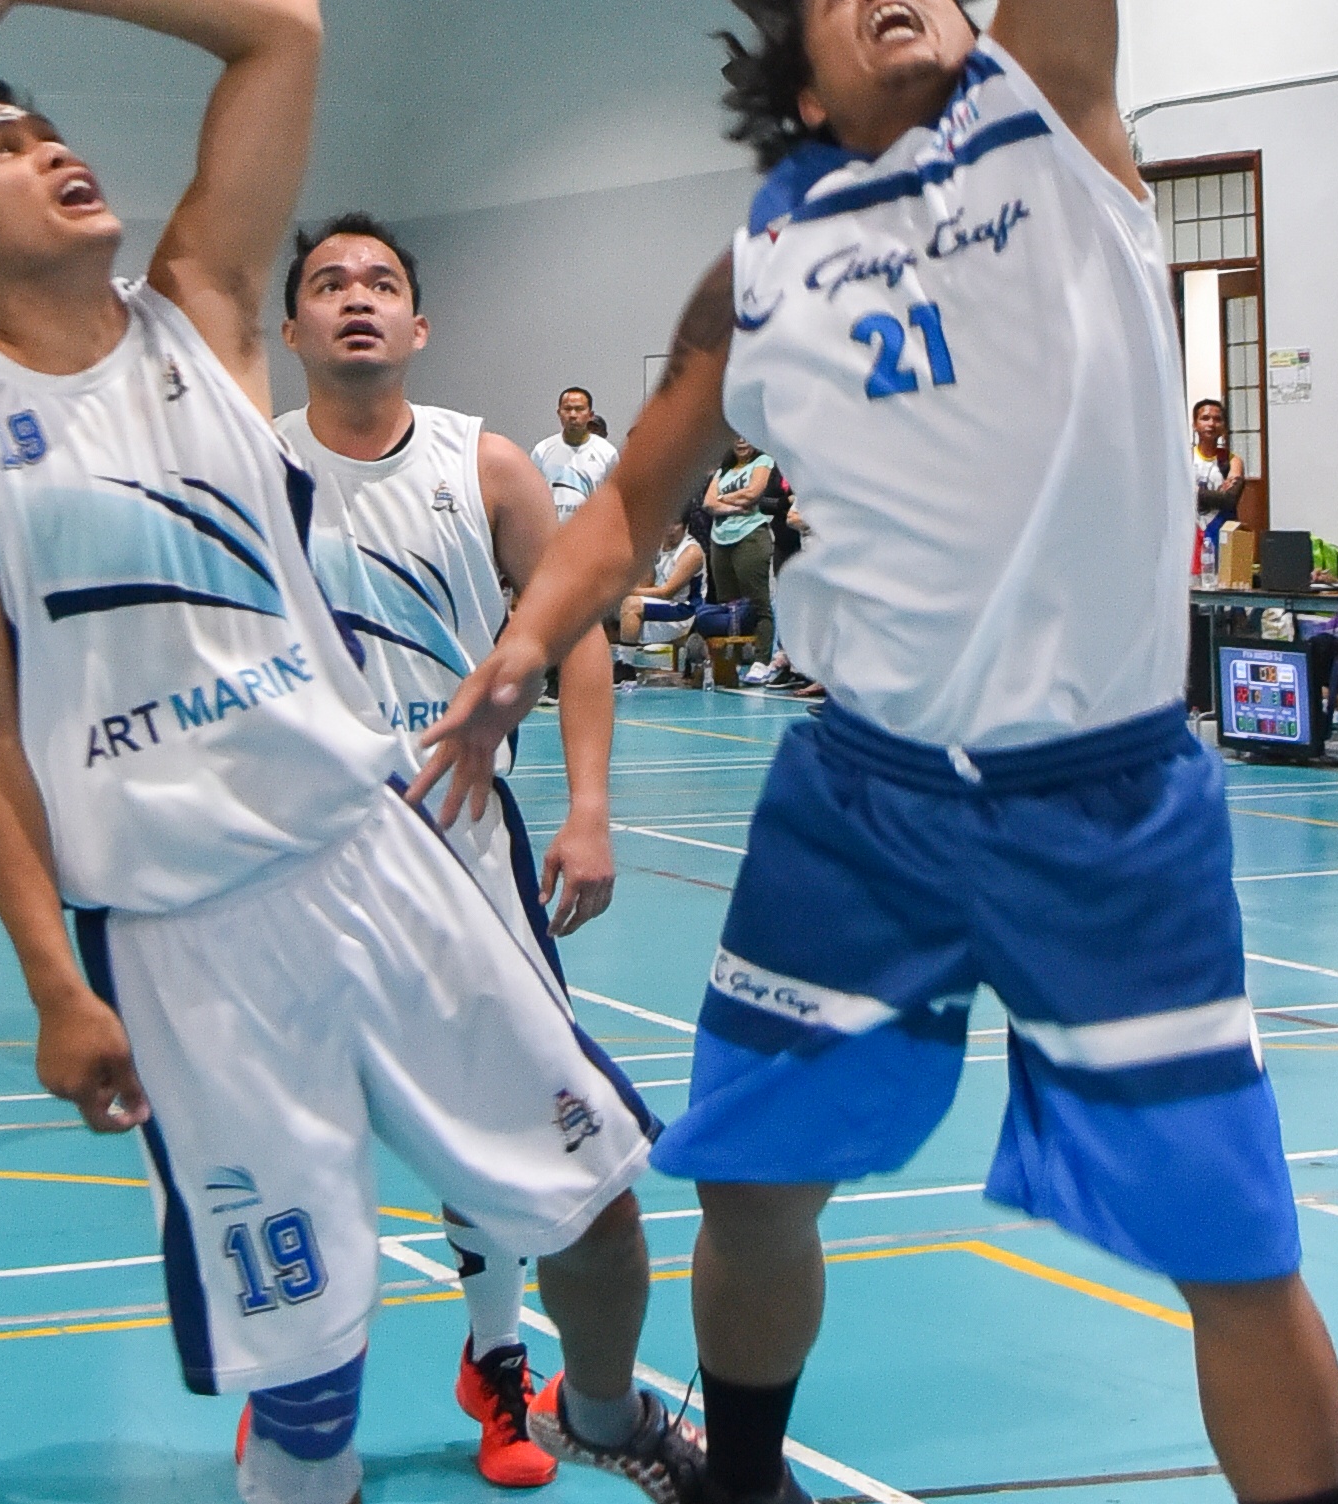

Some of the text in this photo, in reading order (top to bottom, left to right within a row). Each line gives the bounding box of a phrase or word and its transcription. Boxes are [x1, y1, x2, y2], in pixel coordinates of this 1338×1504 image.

[925, 198, 1031, 259] Craft
[849, 300, 957, 400] 21
[84, 642, 315, 768] ART MARINE
[224, 1207, 330, 1318] 19
